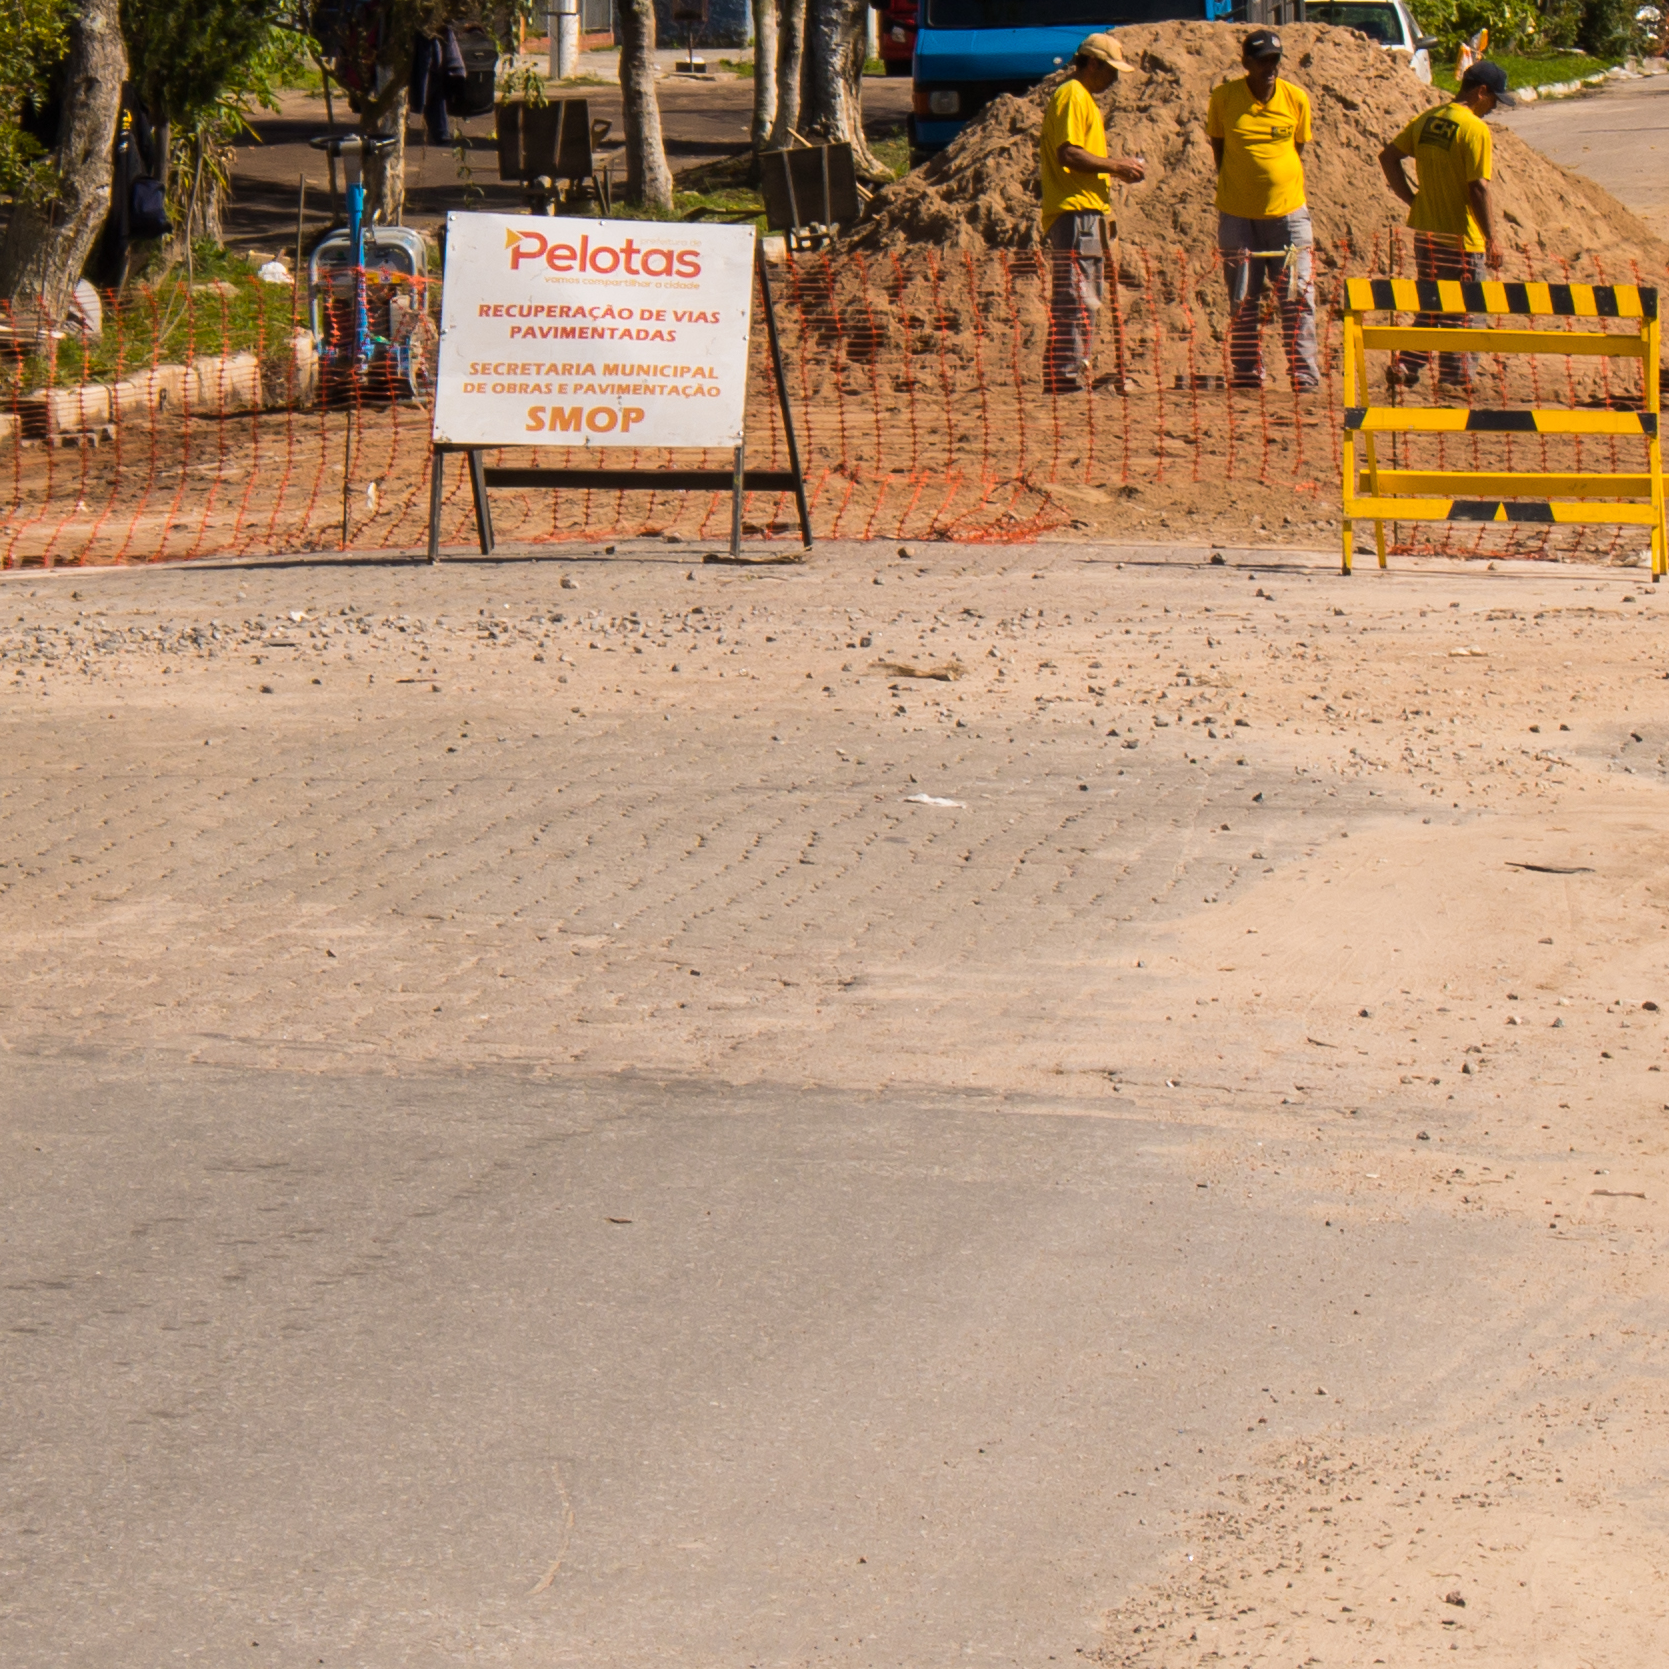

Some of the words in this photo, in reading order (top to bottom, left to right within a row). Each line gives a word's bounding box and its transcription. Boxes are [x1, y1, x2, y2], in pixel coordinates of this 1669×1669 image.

[639, 237, 688, 247] prefeitura
[690, 238, 702, 247] de
[506, 230, 702, 279] Pelotas
[544, 275, 581, 284] vamos
[582, 276, 652, 288] compartilhar
[655, 281, 663, 289] a
[664, 280, 701, 290] cidade
[477, 303, 634, 321] RECUPERAÇÃO
[639, 308, 666, 322] DE
[672, 309, 721, 324] VIAS
[508, 325, 677, 342] PAVIMENTADAS
[468, 361, 597, 376] SECRETARIA
[600, 363, 719, 380] MUNICIPAL
[462, 382, 487, 394] DE
[490, 382, 553, 395] OBRAS
[557, 382, 568, 395] E
[572, 383, 721, 399] PAVIMENTAÇÃO
[524, 405, 645, 433] SMOP
